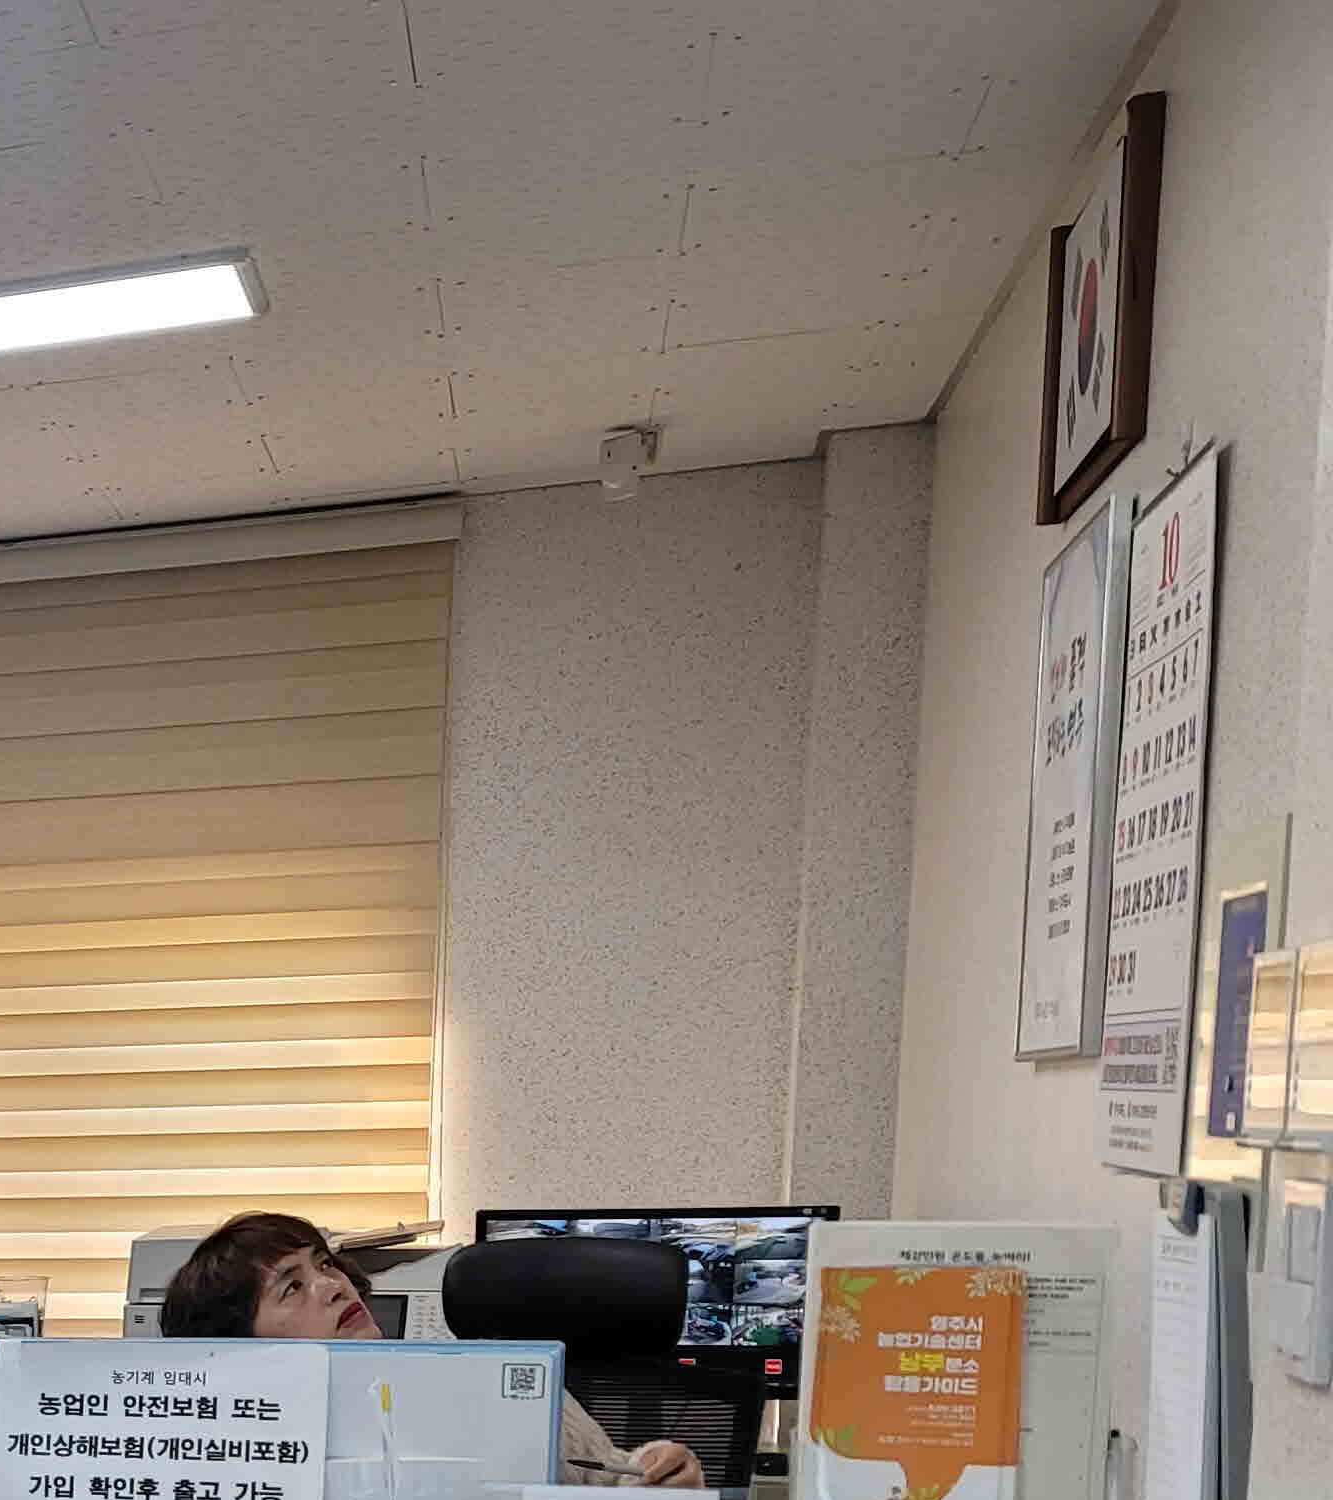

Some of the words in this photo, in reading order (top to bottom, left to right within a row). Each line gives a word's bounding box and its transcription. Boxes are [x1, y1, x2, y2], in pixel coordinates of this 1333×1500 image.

[1158, 512, 1180, 590] 10
[111, 1370, 155, 1384] 농기계
[164, 1371, 207, 1386] 임대시
[38, 1393, 108, 1416] 농업인
[123, 1395, 217, 1419] 안전보험
[232, 1398, 281, 1421] 또는
[7, 1434, 309, 1464] 개인상해보험(개인실비포함)
[29, 1475, 75, 1498] 가입
[89, 1476, 160, 1500] 확인후
